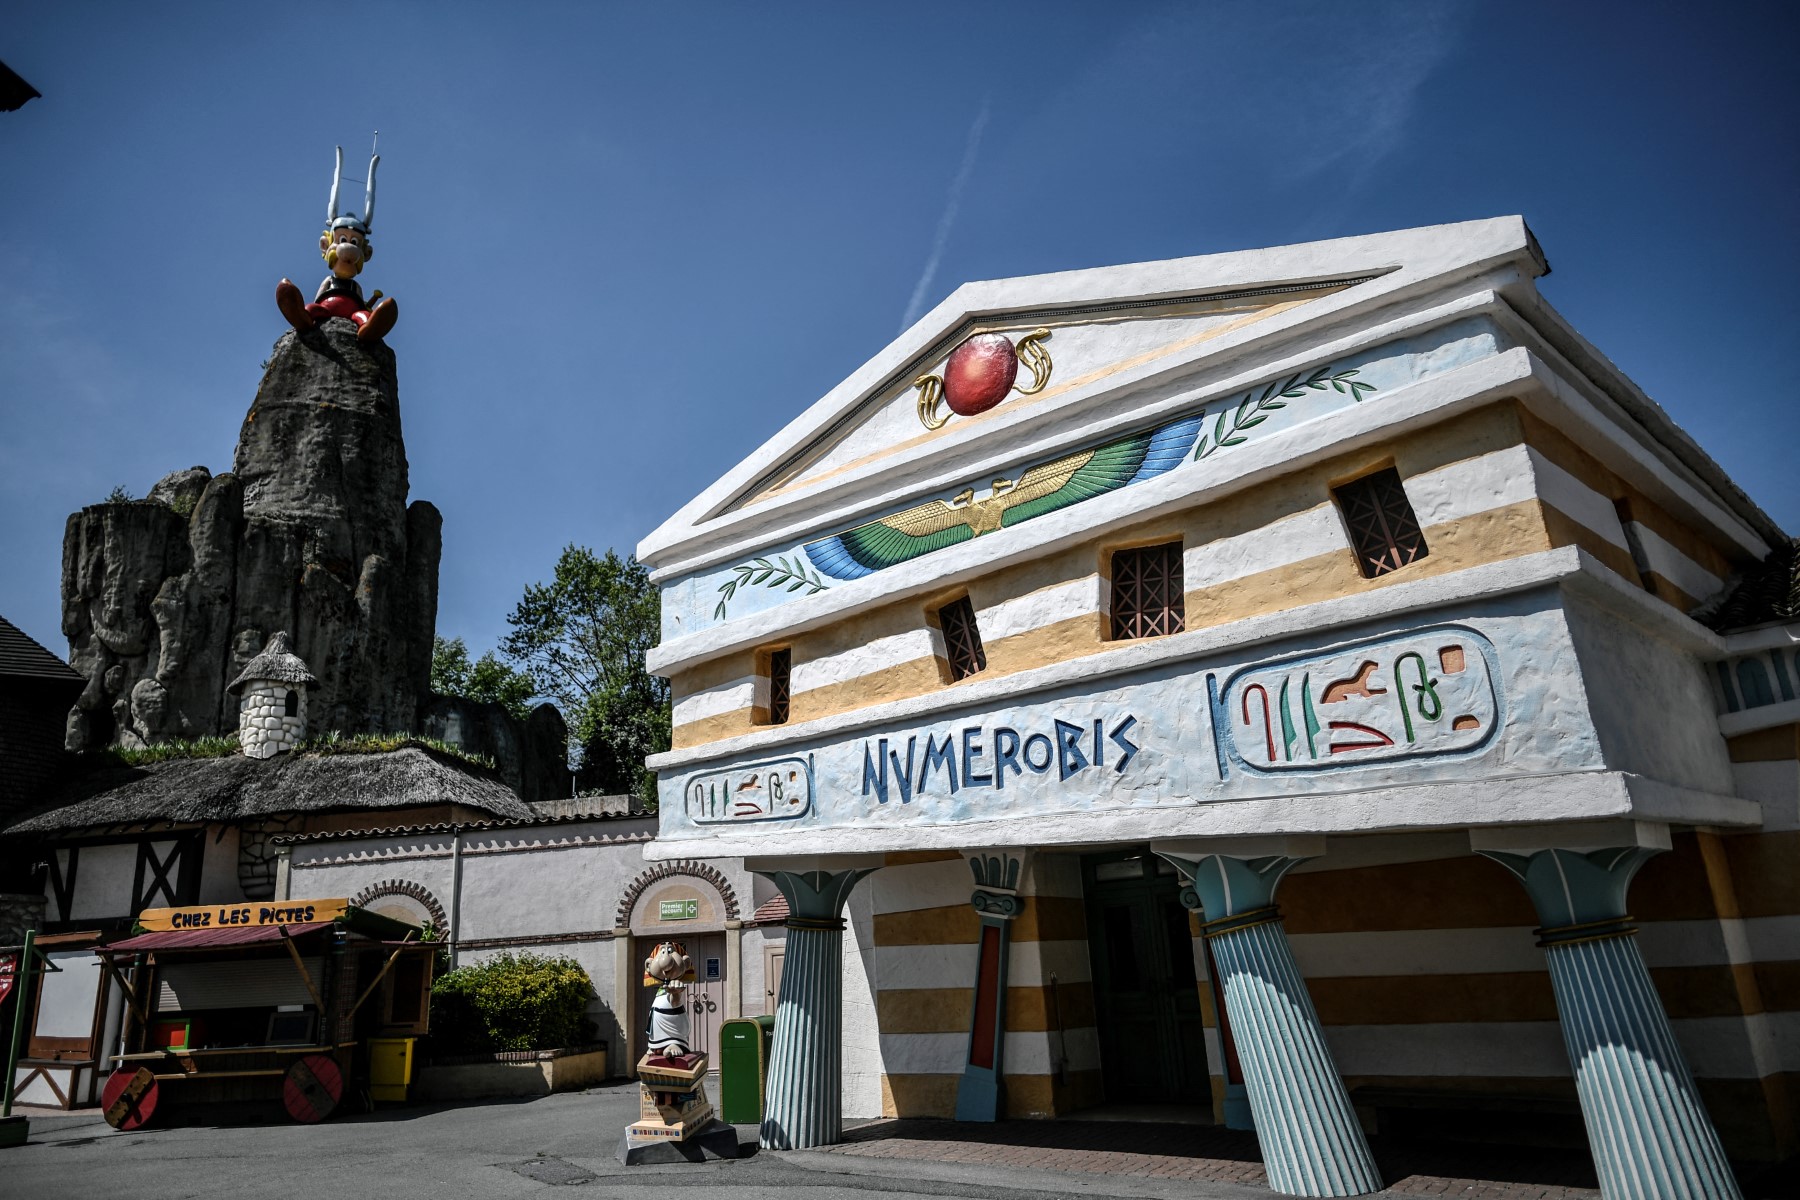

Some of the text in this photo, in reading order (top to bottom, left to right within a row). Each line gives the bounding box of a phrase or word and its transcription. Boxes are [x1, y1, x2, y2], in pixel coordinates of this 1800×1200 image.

[861, 714, 1139, 804] NVMEROBIS
[171, 912, 211, 928] CHEZ
[218, 908, 251, 924] LES
